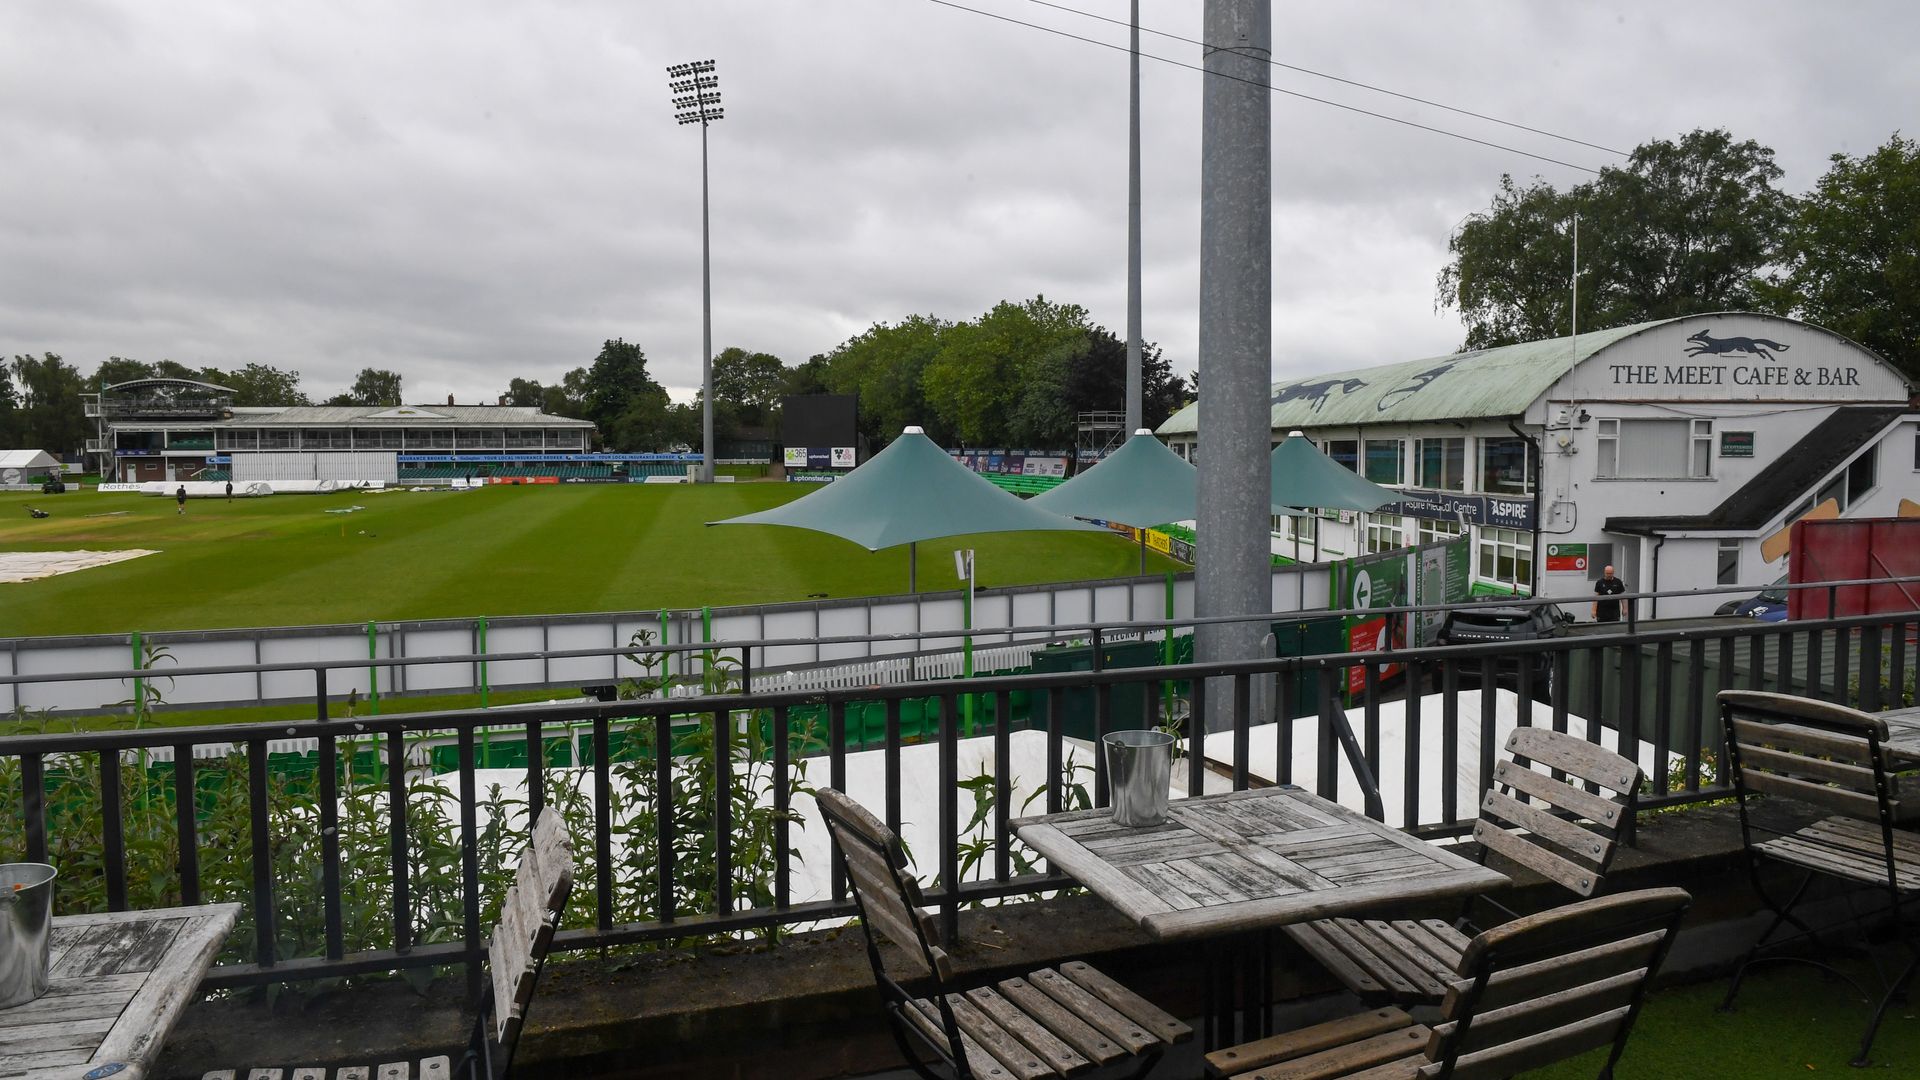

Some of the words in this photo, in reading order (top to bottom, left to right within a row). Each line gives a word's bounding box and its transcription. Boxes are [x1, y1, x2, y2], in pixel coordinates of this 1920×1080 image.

[1609, 365, 1658, 385] THE
[1663, 365, 1727, 385] MEET
[1733, 366, 1788, 385] CAFE
[1794, 367, 1812, 386] &
[1817, 367, 1860, 386] BAR
[794, 448, 807, 458] 365
[1405, 501, 1425, 511] Aspire
[1453, 500, 1478, 516] Centre
[1490, 499, 1527, 519] ASPIRE
